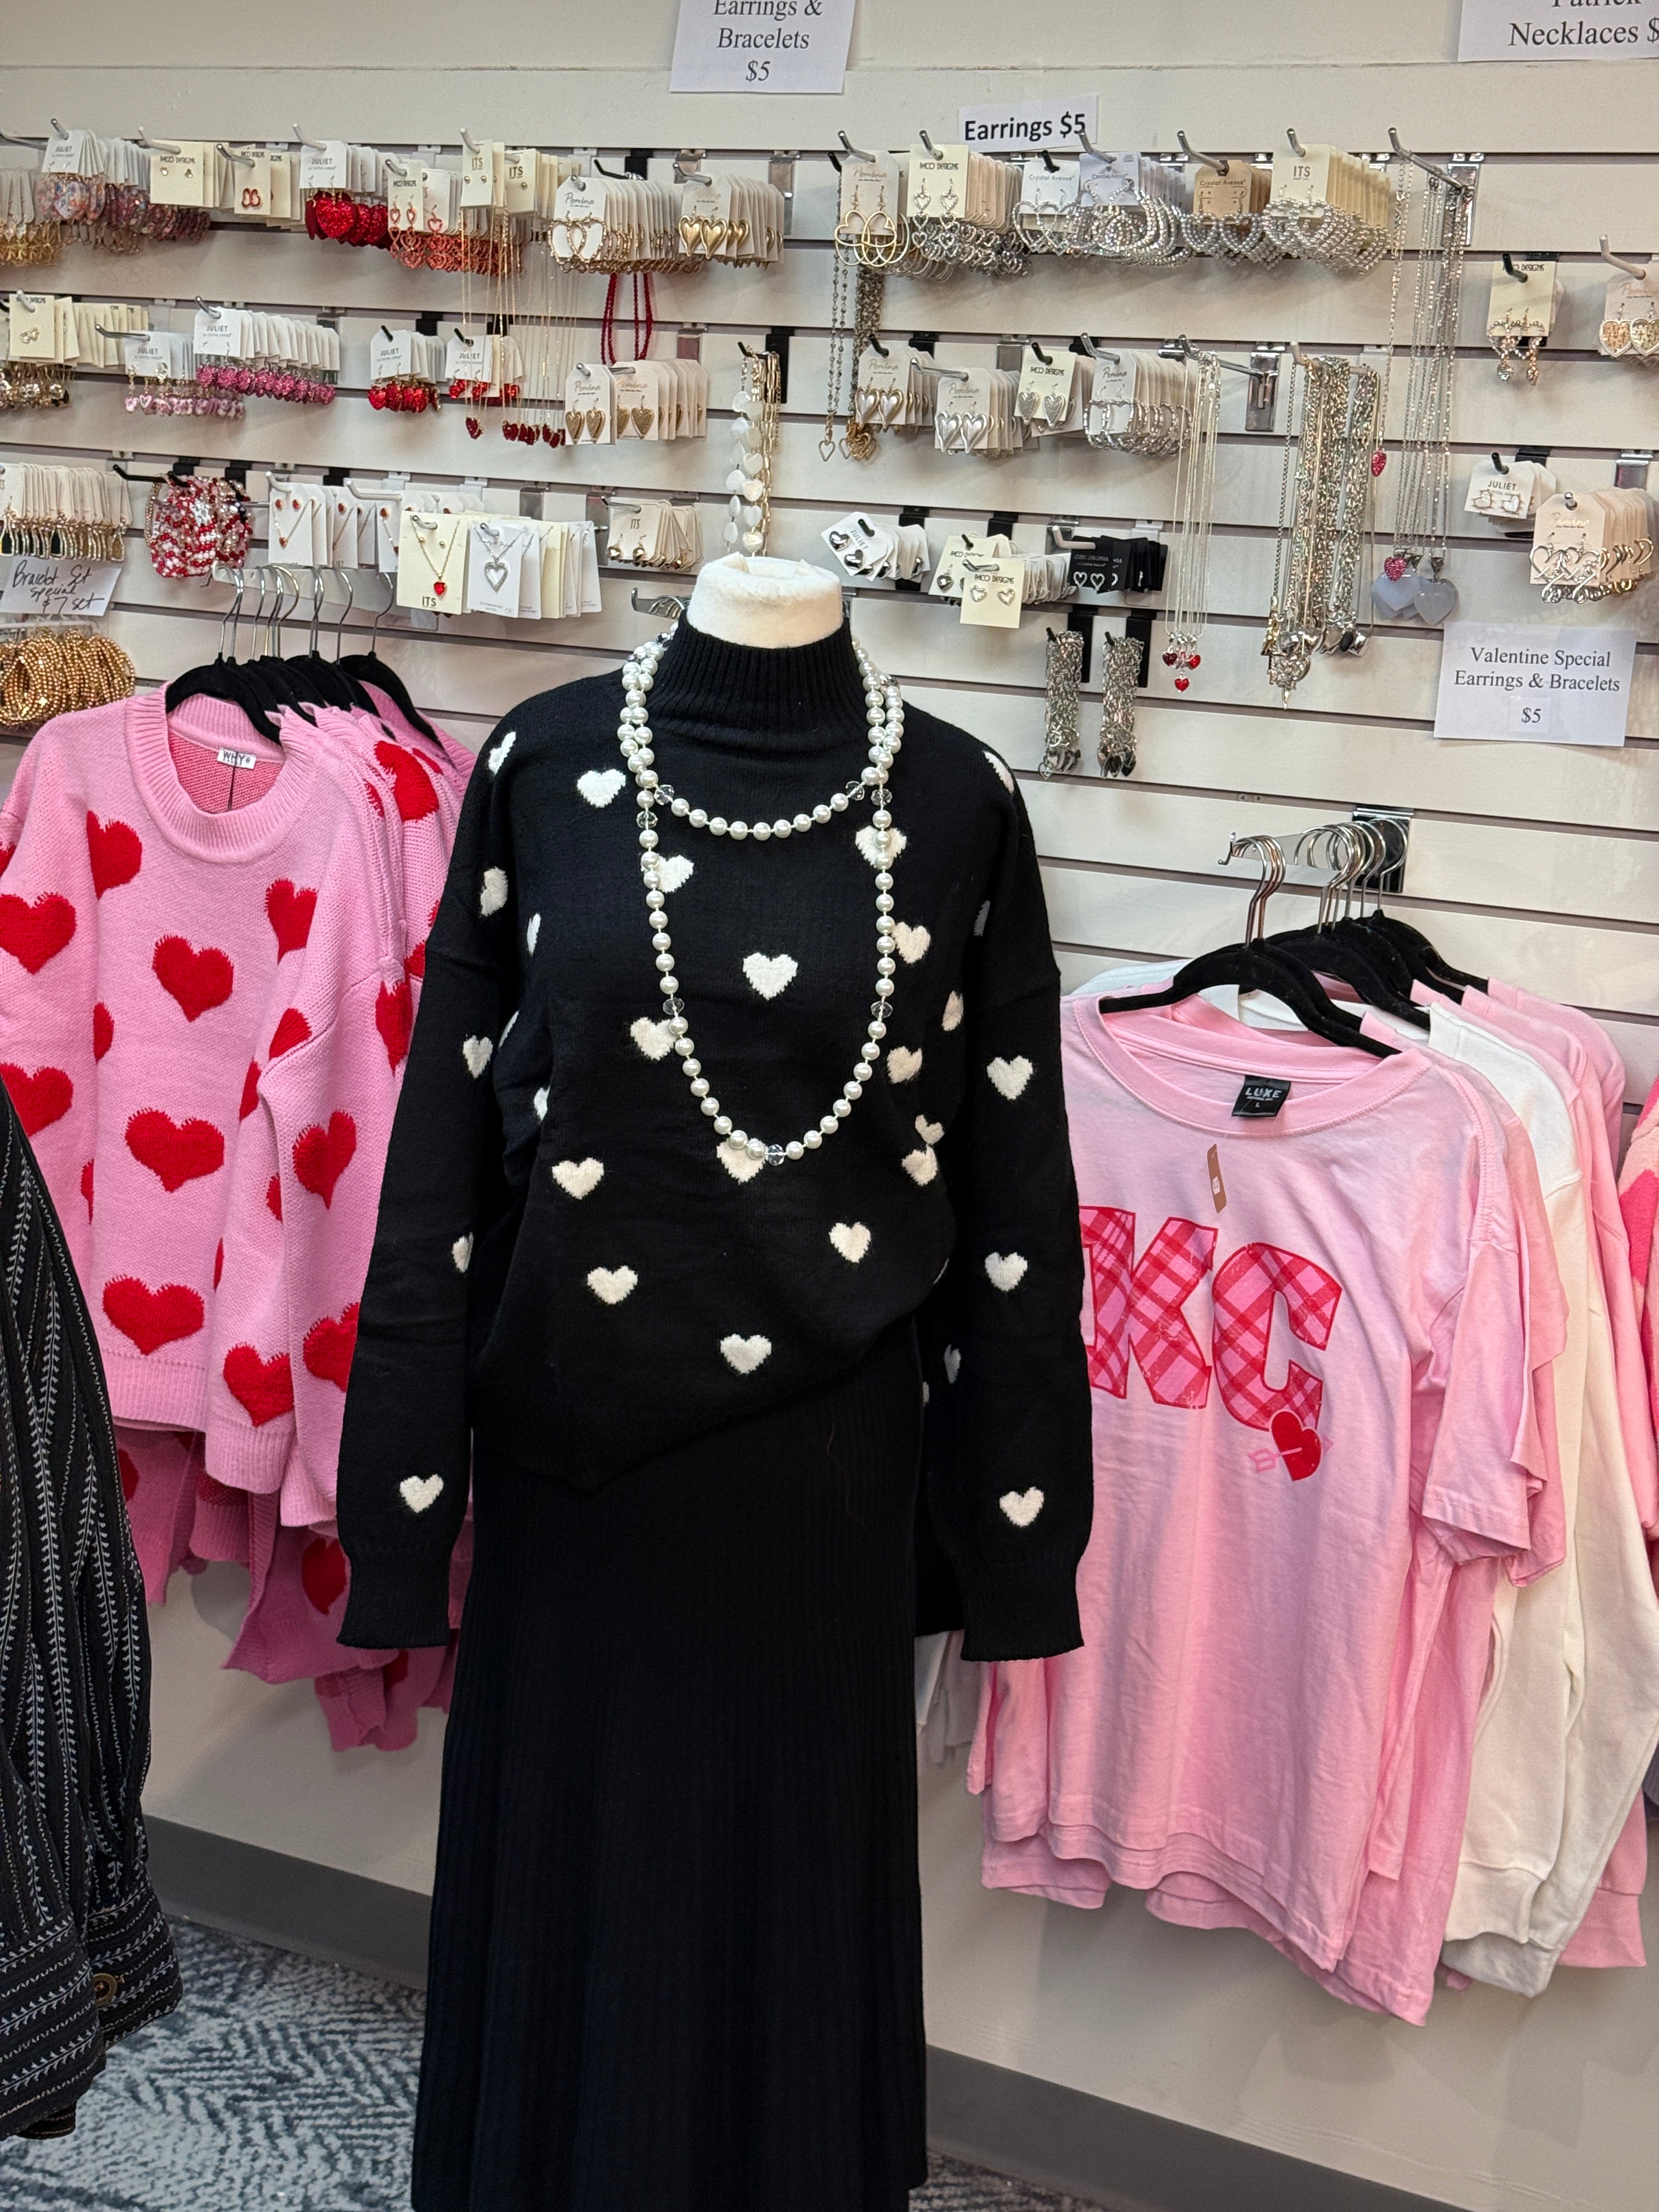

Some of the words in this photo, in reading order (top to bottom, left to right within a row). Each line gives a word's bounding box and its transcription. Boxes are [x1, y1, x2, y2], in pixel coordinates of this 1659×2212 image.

[713, 0, 797, 21] Earrings
[804, 0, 823, 15] &
[716, 27, 810, 49] Bracelets
[1508, 21, 1639, 47] Necklaces
[745, 60, 771, 83] $5
[964, 117, 1053, 142] Earrings
[1059, 111, 1086, 138] $5
[472, 157, 483, 168] ITS
[1293, 165, 1311, 177] ITS
[509, 166, 523, 177] ITS
[380, 347, 399, 357] JULIET
[1487, 479, 1517, 491] JULIET
[630, 518, 641, 529] ITS
[850, 529, 868, 550] JULIET
[422, 596, 437, 607] ITS
[1470, 647, 1549, 665] Valentine
[1554, 650, 1611, 669] Special
[1454, 670, 1523, 691] Earrings
[1528, 673, 1544, 689] &
[1549, 674, 1621, 692] Bracelets
[1521, 707, 1542, 724] $5
[1244, 1087, 1282, 1098] LUXE
